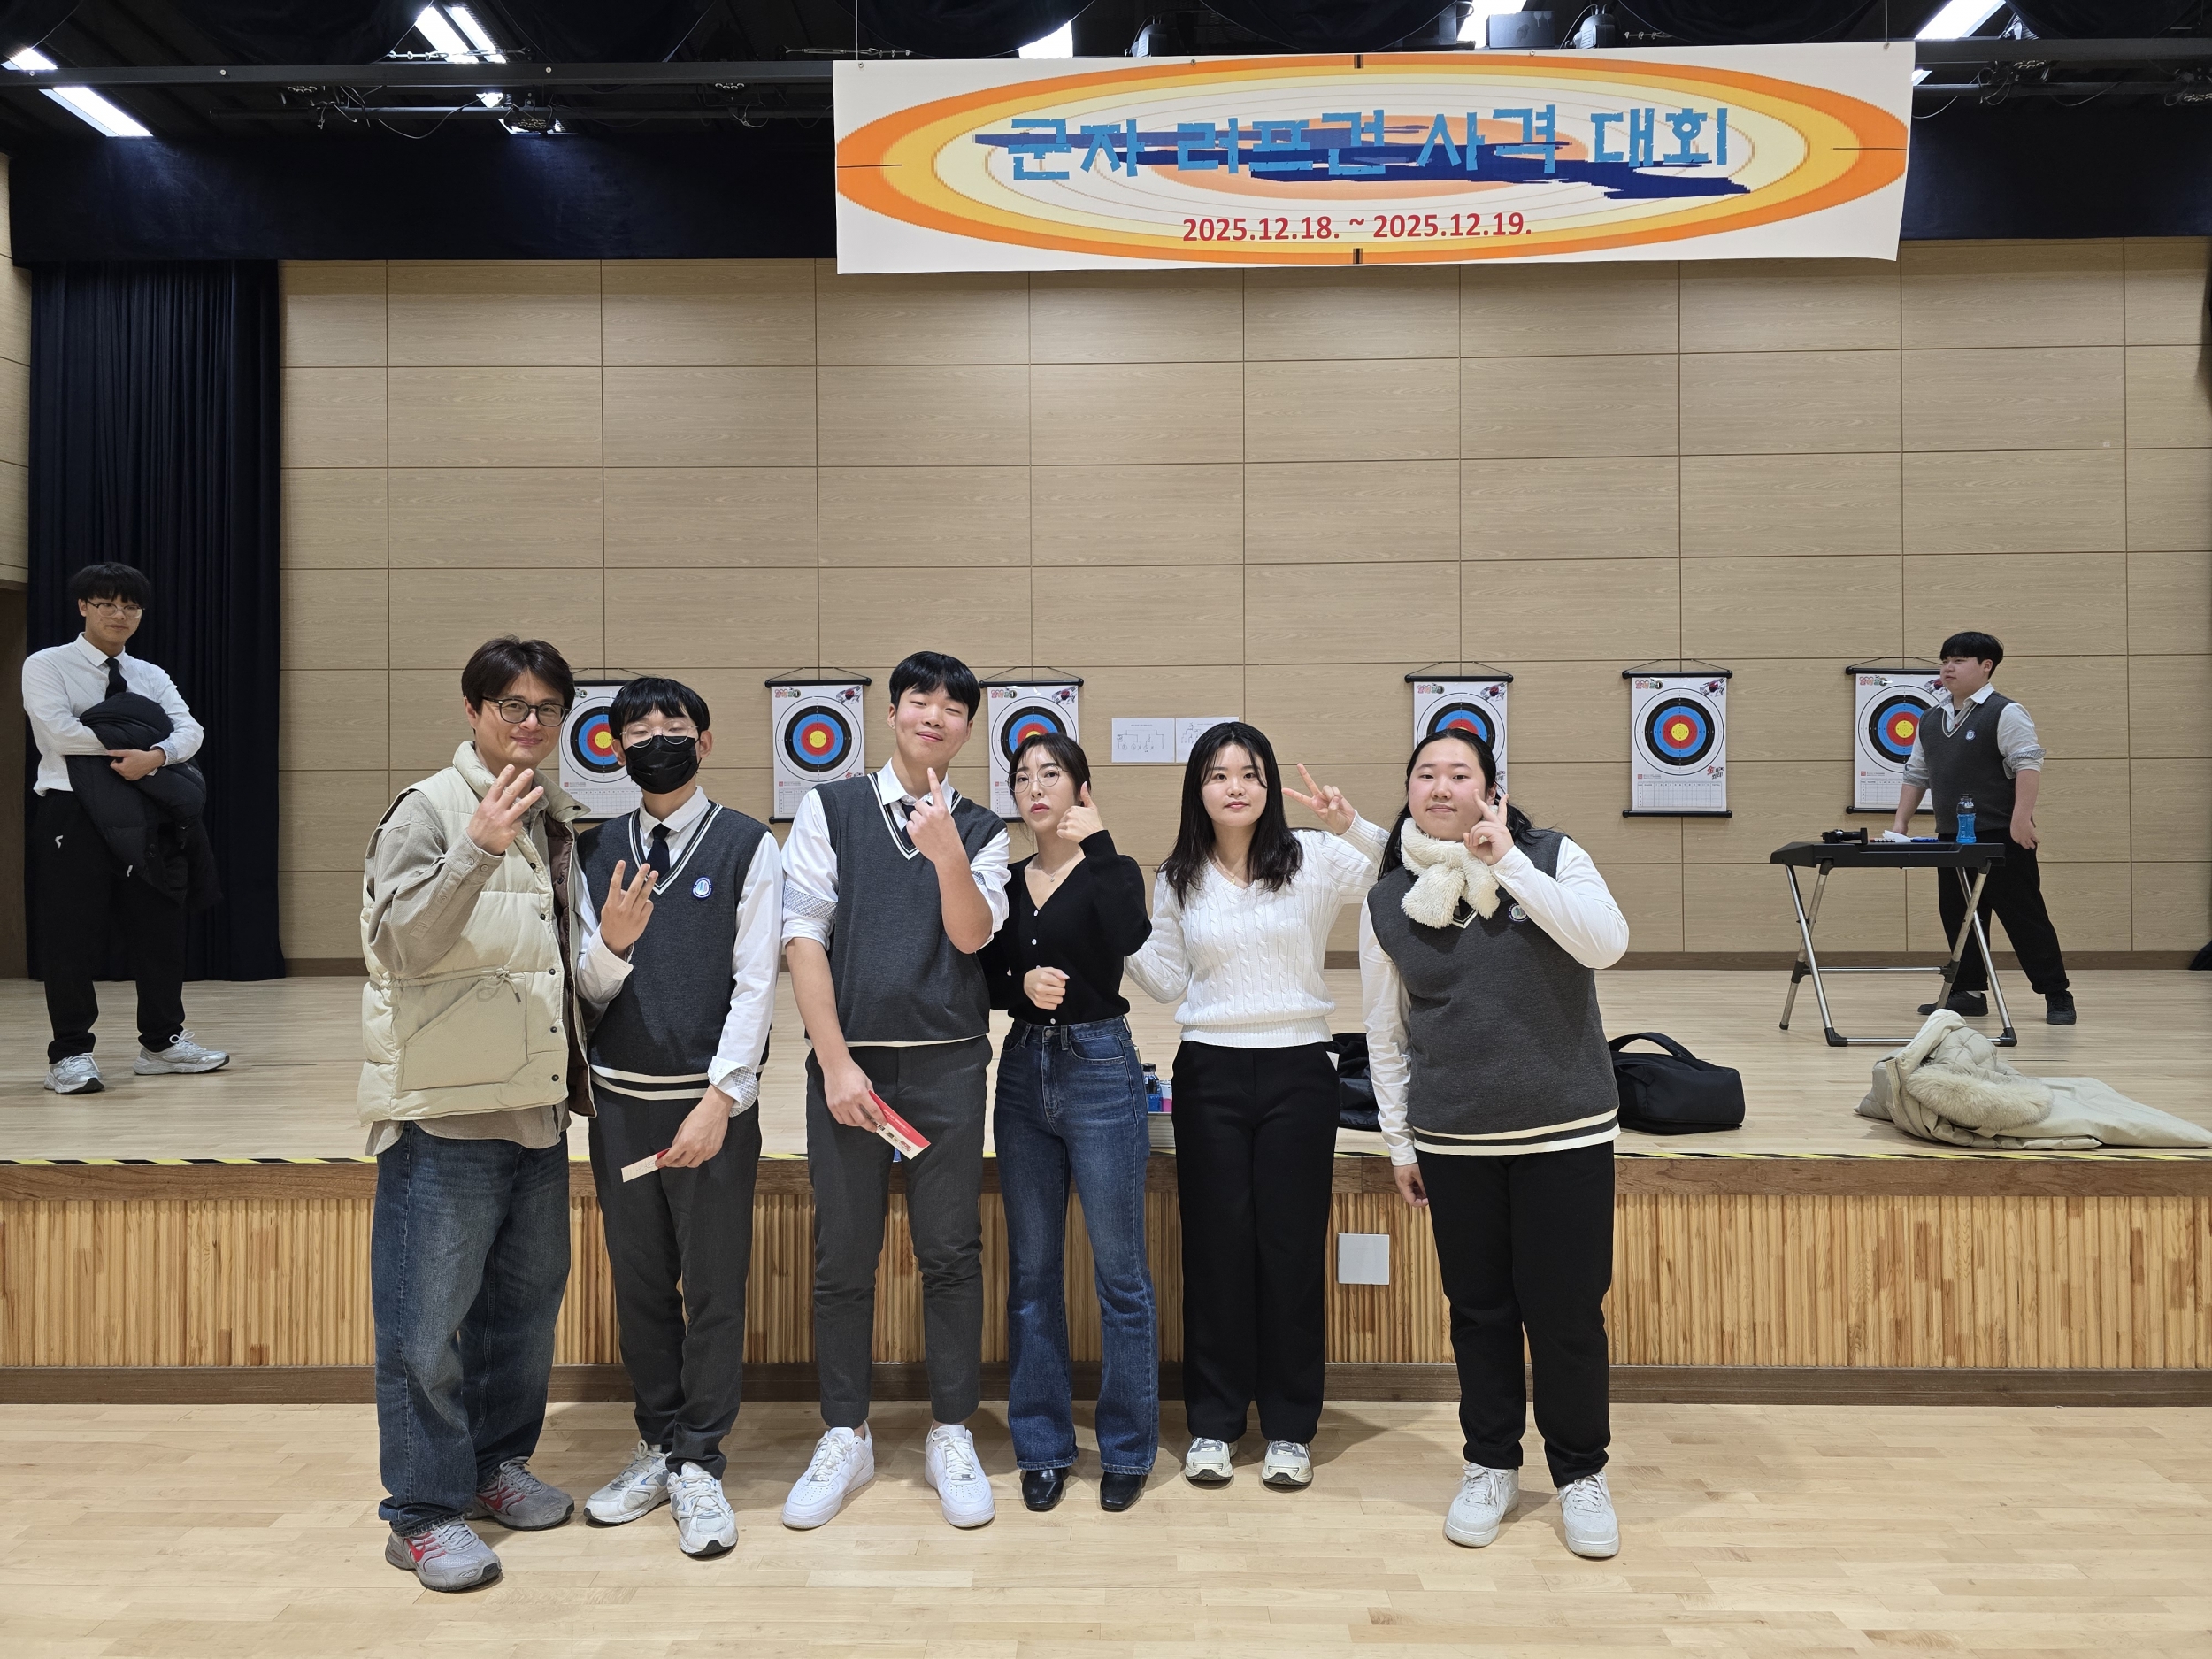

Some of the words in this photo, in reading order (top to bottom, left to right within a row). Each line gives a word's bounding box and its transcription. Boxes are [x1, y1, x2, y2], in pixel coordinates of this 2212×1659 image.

[1008, 119, 1146, 180] 군자
[1177, 109, 1386, 175] 러프건
[1416, 104, 1556, 173] 사격
[1590, 107, 1728, 167] 대회
[1183, 216, 1340, 242] 2025.12.18.
[1373, 212, 1532, 238] 2025.12.19.
